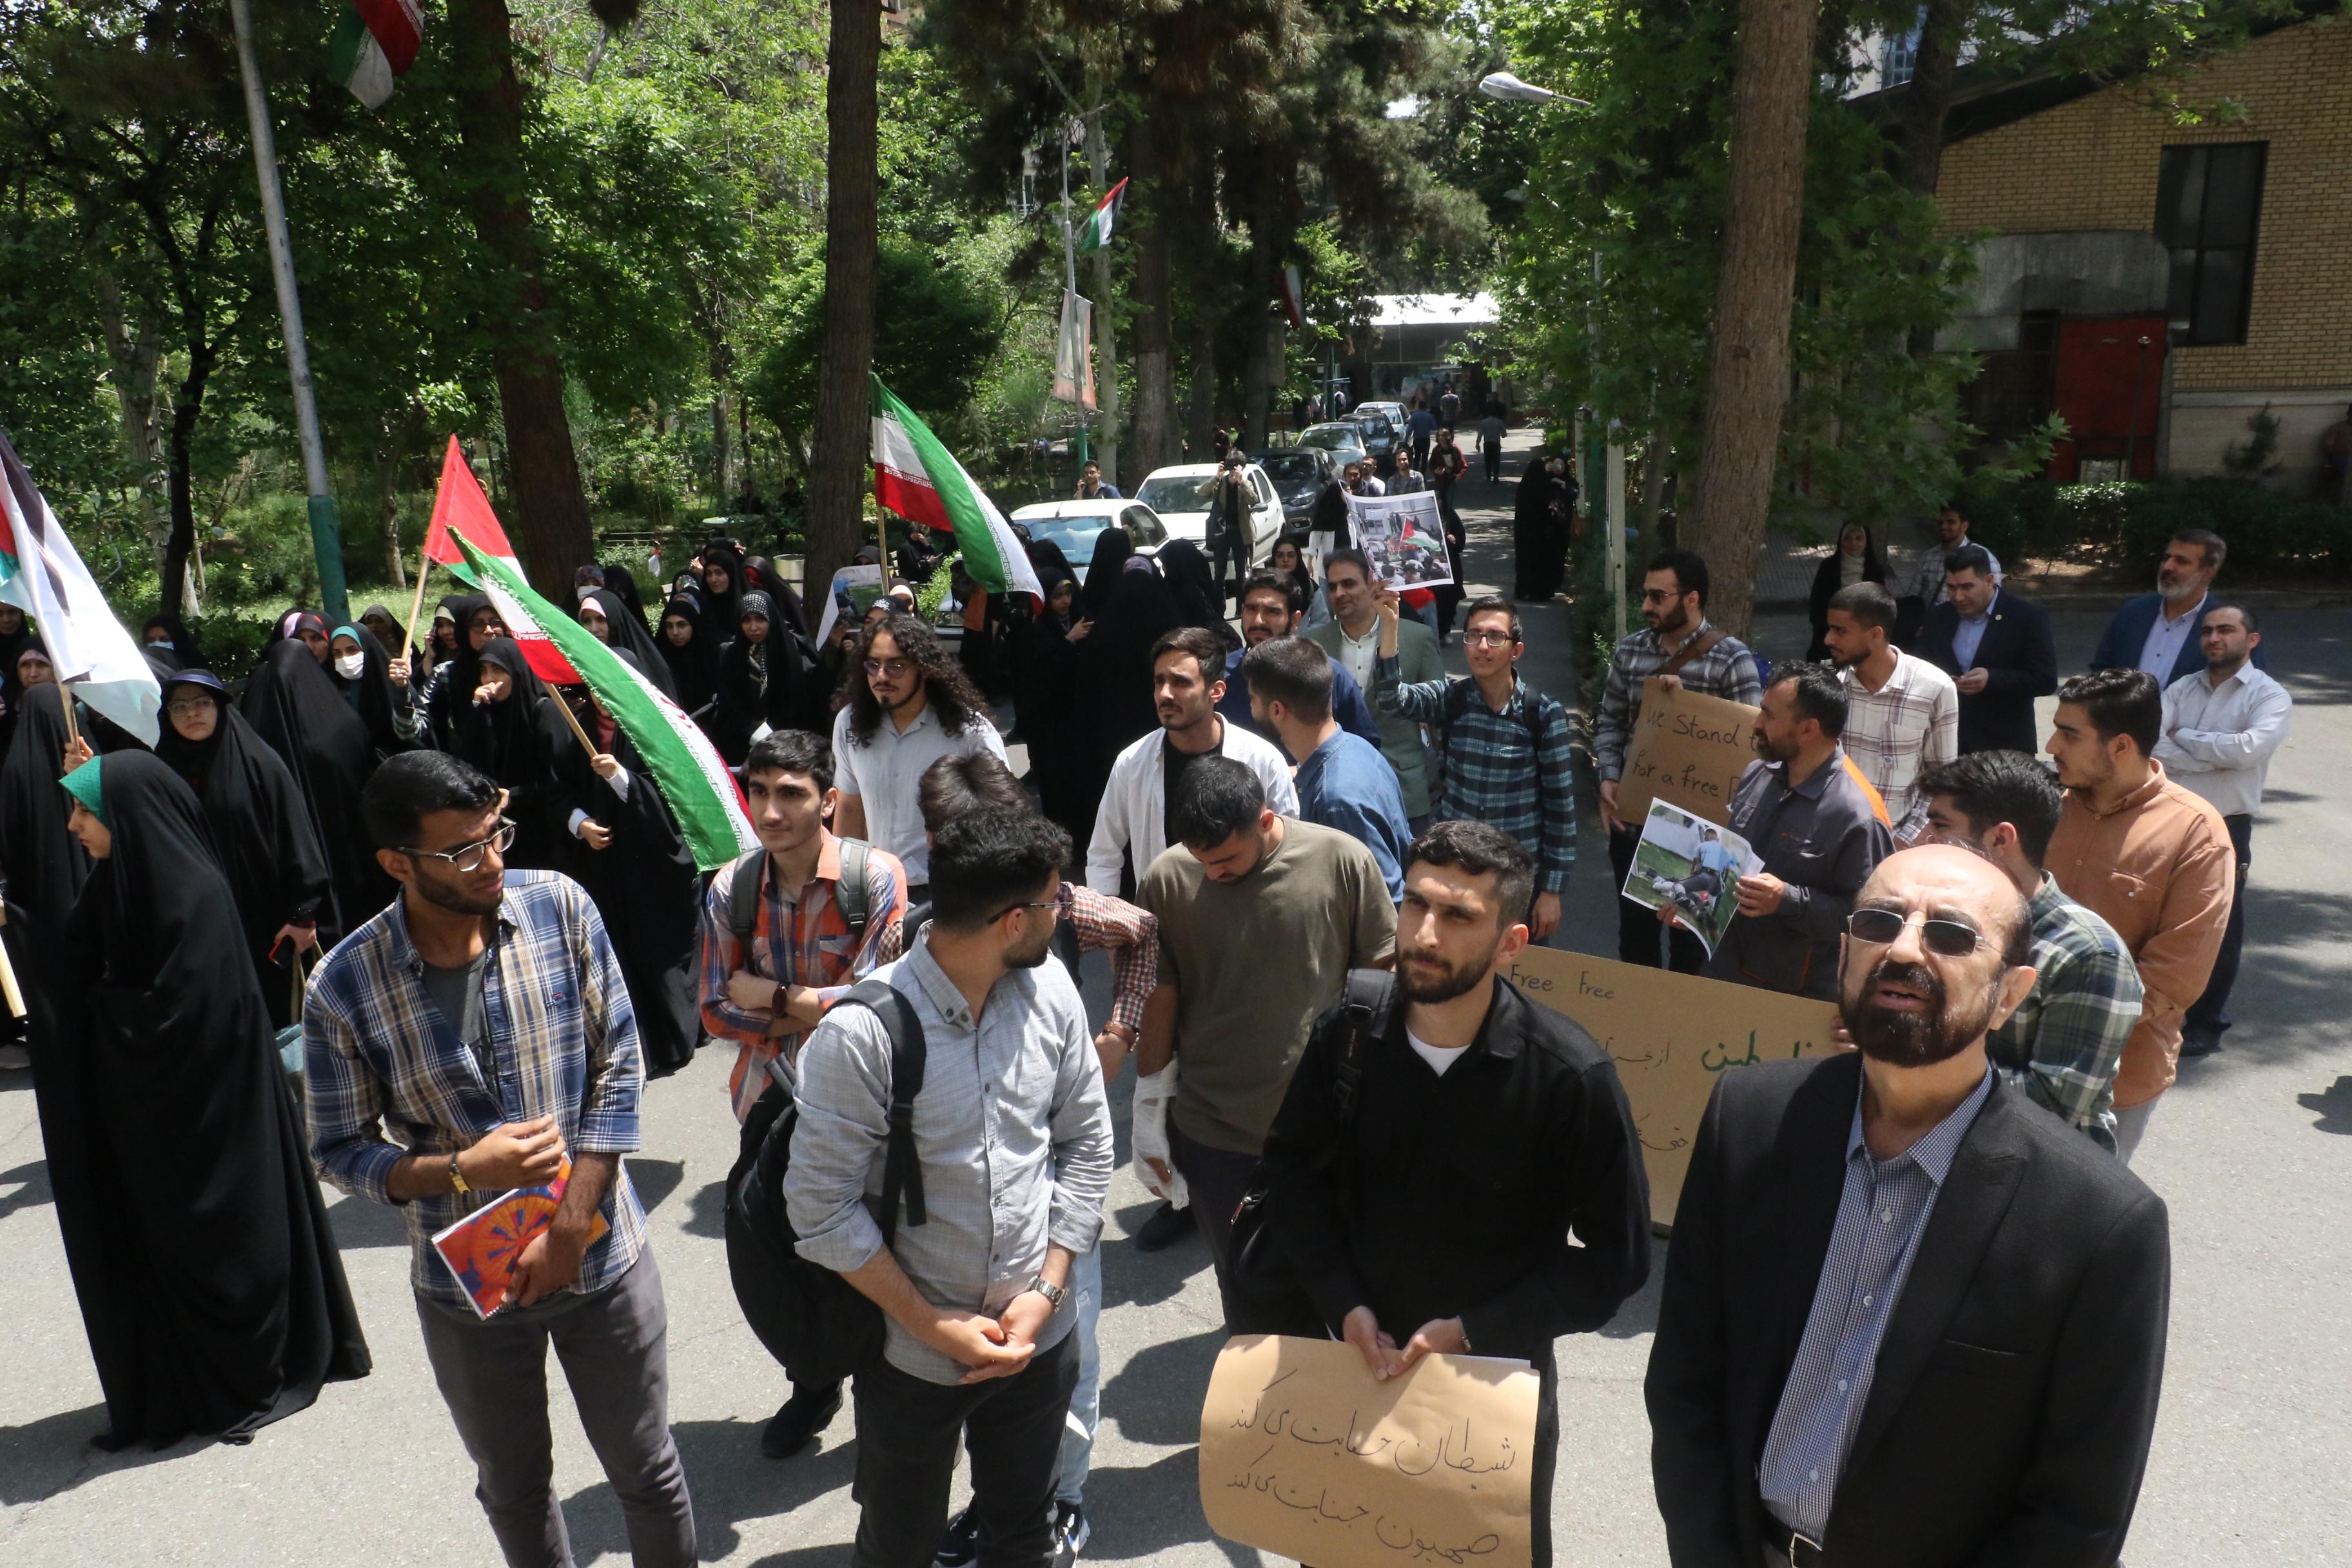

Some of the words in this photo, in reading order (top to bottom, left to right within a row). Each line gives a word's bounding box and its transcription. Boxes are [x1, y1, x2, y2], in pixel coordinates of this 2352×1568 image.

[1672, 714, 1740, 747] Stand
[1661, 774, 1674, 787] a
[1510, 964, 1554, 992] Free
[1578, 970, 1615, 999] Free
[1290, 1409, 1393, 1457] حمایت
[1394, 1417, 1516, 1490] شیطان
[1273, 1484, 1369, 1529] جنایت
[1375, 1515, 1500, 1565] صهیون
